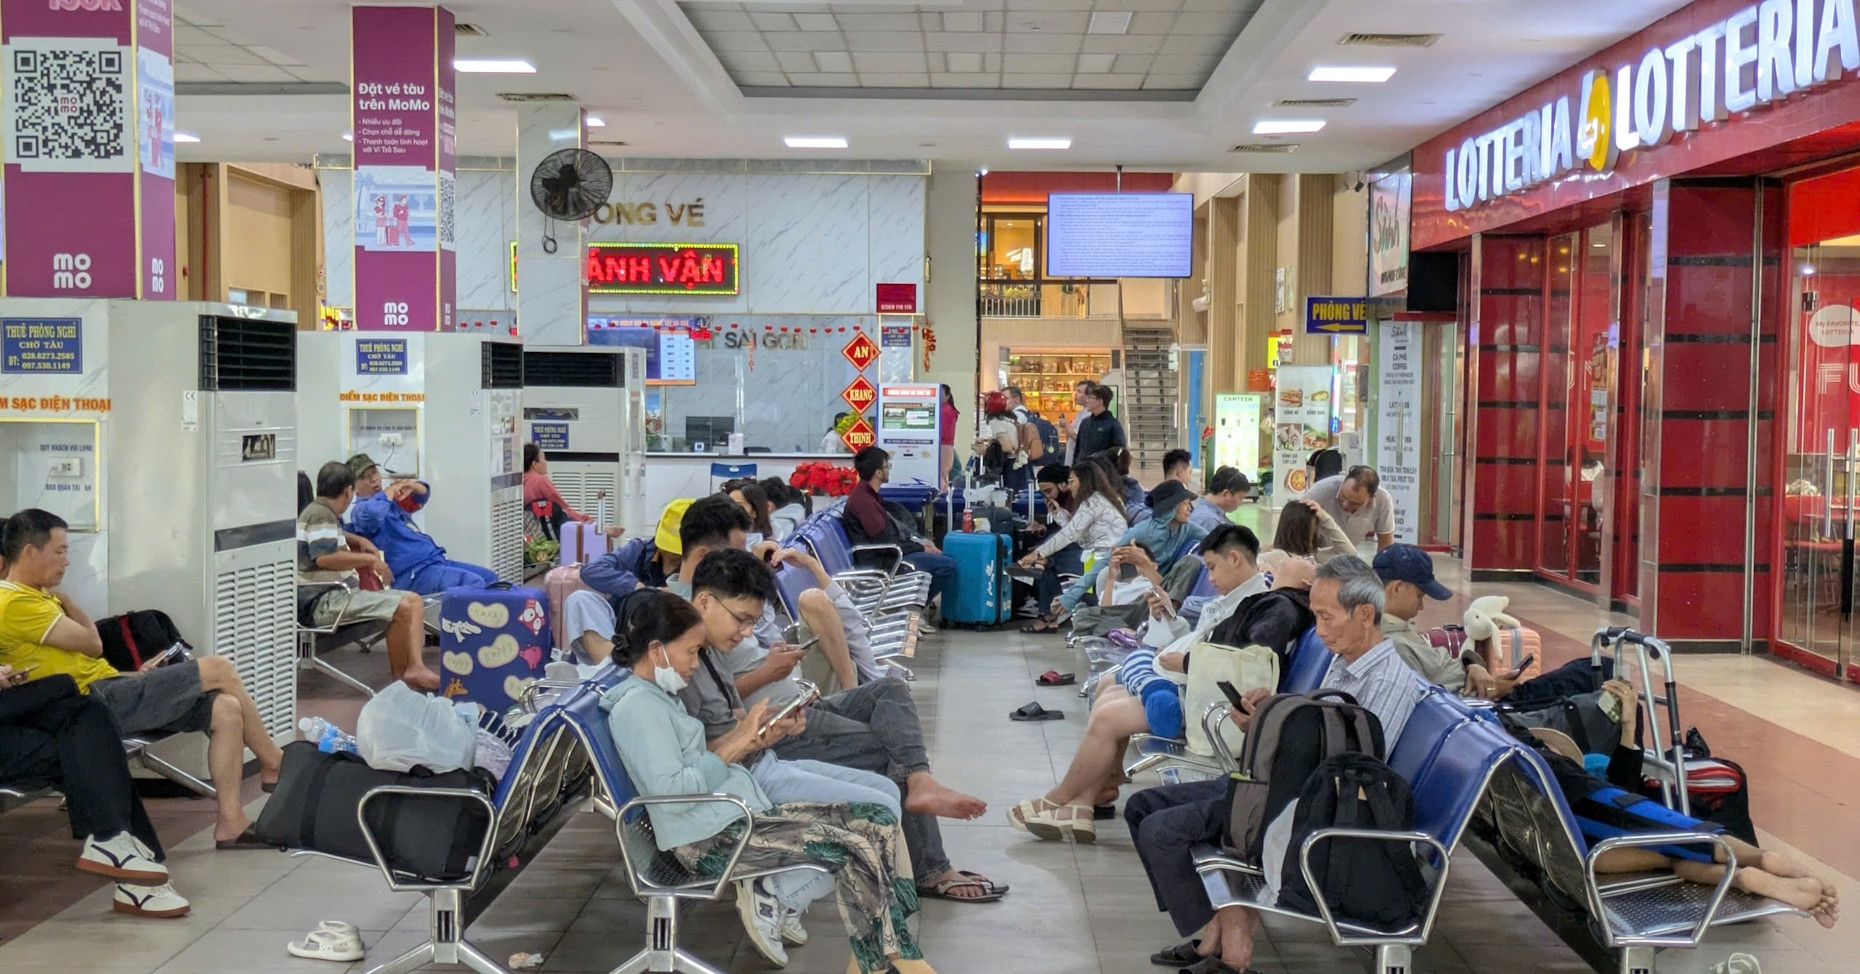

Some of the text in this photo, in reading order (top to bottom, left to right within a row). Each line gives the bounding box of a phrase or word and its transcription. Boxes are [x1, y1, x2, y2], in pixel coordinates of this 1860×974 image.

[1616, 0, 1860, 151] LOTTERIA
[358, 82, 425, 97] Đặt vé tàu
[359, 98, 430, 110] trên MoMo
[1444, 95, 1573, 212] LOTTERIA
[665, 197, 705, 227] VÉ
[53, 253, 91, 270] mo
[659, 250, 724, 289] VẬN
[54, 272, 92, 289] mo
[384, 302, 409, 314] mo
[1312, 300, 1350, 320] PHÒNG
[384, 314, 409, 325] mo
[6, 321, 76, 338] THUÊ PHÒNG NGHỈ
[19, 339, 64, 349] CHỜ TÀU
[853, 346, 869, 358] AN
[339, 390, 425, 403] ĐIỂM SẠC ĐIỆN THOẠI
[849, 389, 873, 401] KHANG
[12, 398, 37, 412] SẠC
[40, 395, 70, 413] ĐIỆN
[73, 398, 113, 413] THOẠI
[849, 432, 872, 446] THỊNH
